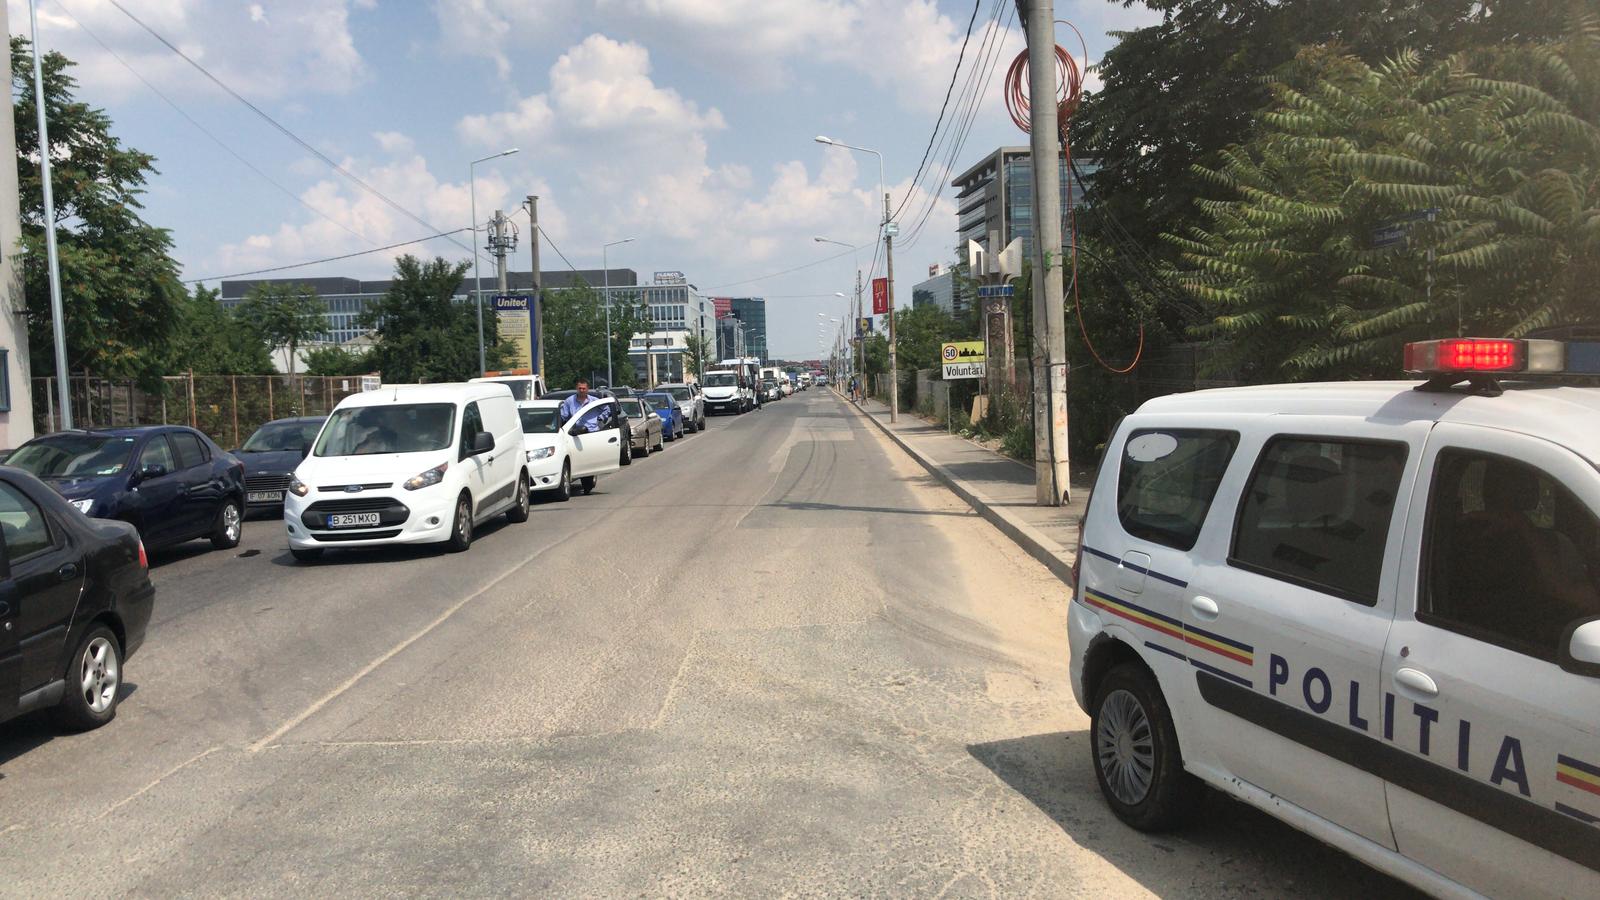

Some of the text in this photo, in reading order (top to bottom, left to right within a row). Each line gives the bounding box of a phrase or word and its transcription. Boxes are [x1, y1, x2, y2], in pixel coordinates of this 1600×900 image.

[497, 298, 527, 307] United
[945, 349, 955, 357] 50
[946, 365, 983, 376] Voluntari
[1269, 653, 1531, 797] POLITIA
